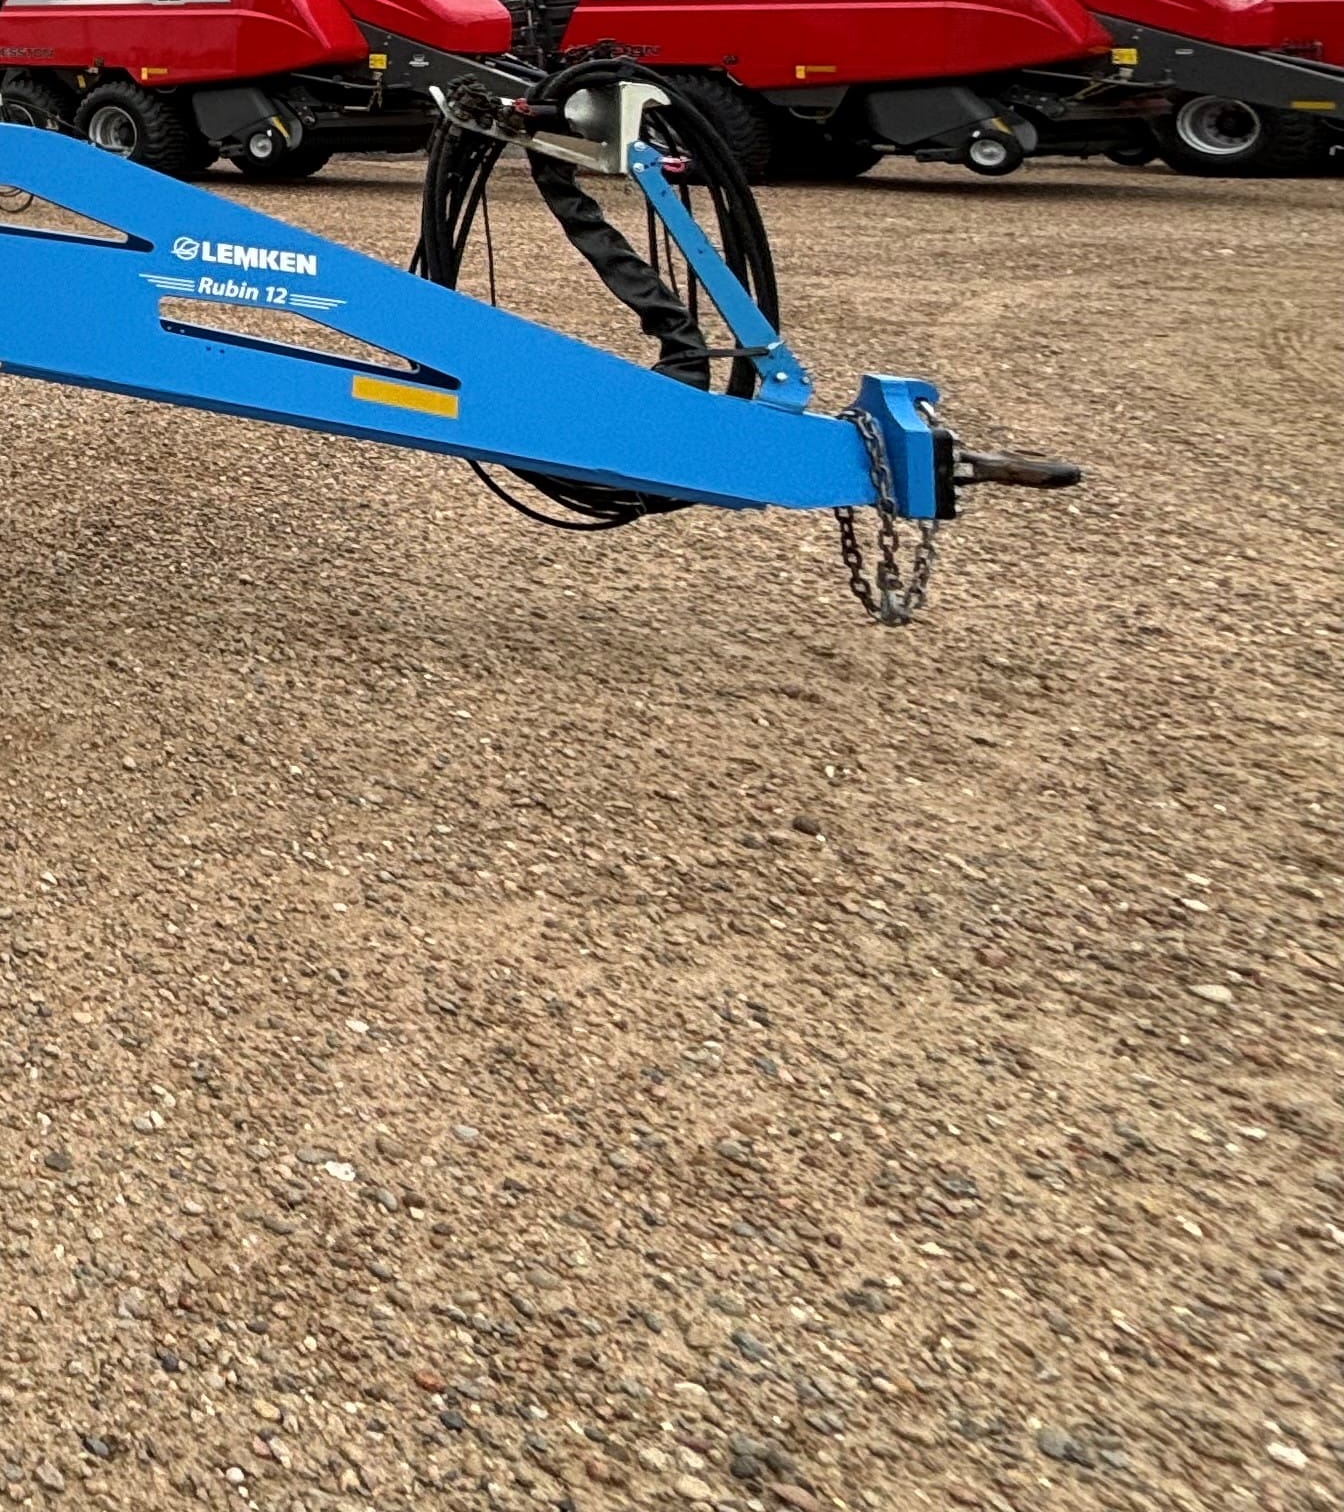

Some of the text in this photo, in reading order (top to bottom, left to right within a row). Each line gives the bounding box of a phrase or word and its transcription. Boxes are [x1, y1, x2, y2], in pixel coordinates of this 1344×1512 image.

[202, 241, 317, 276] LEMKEN
[198, 276, 288, 305] Rubin 12
